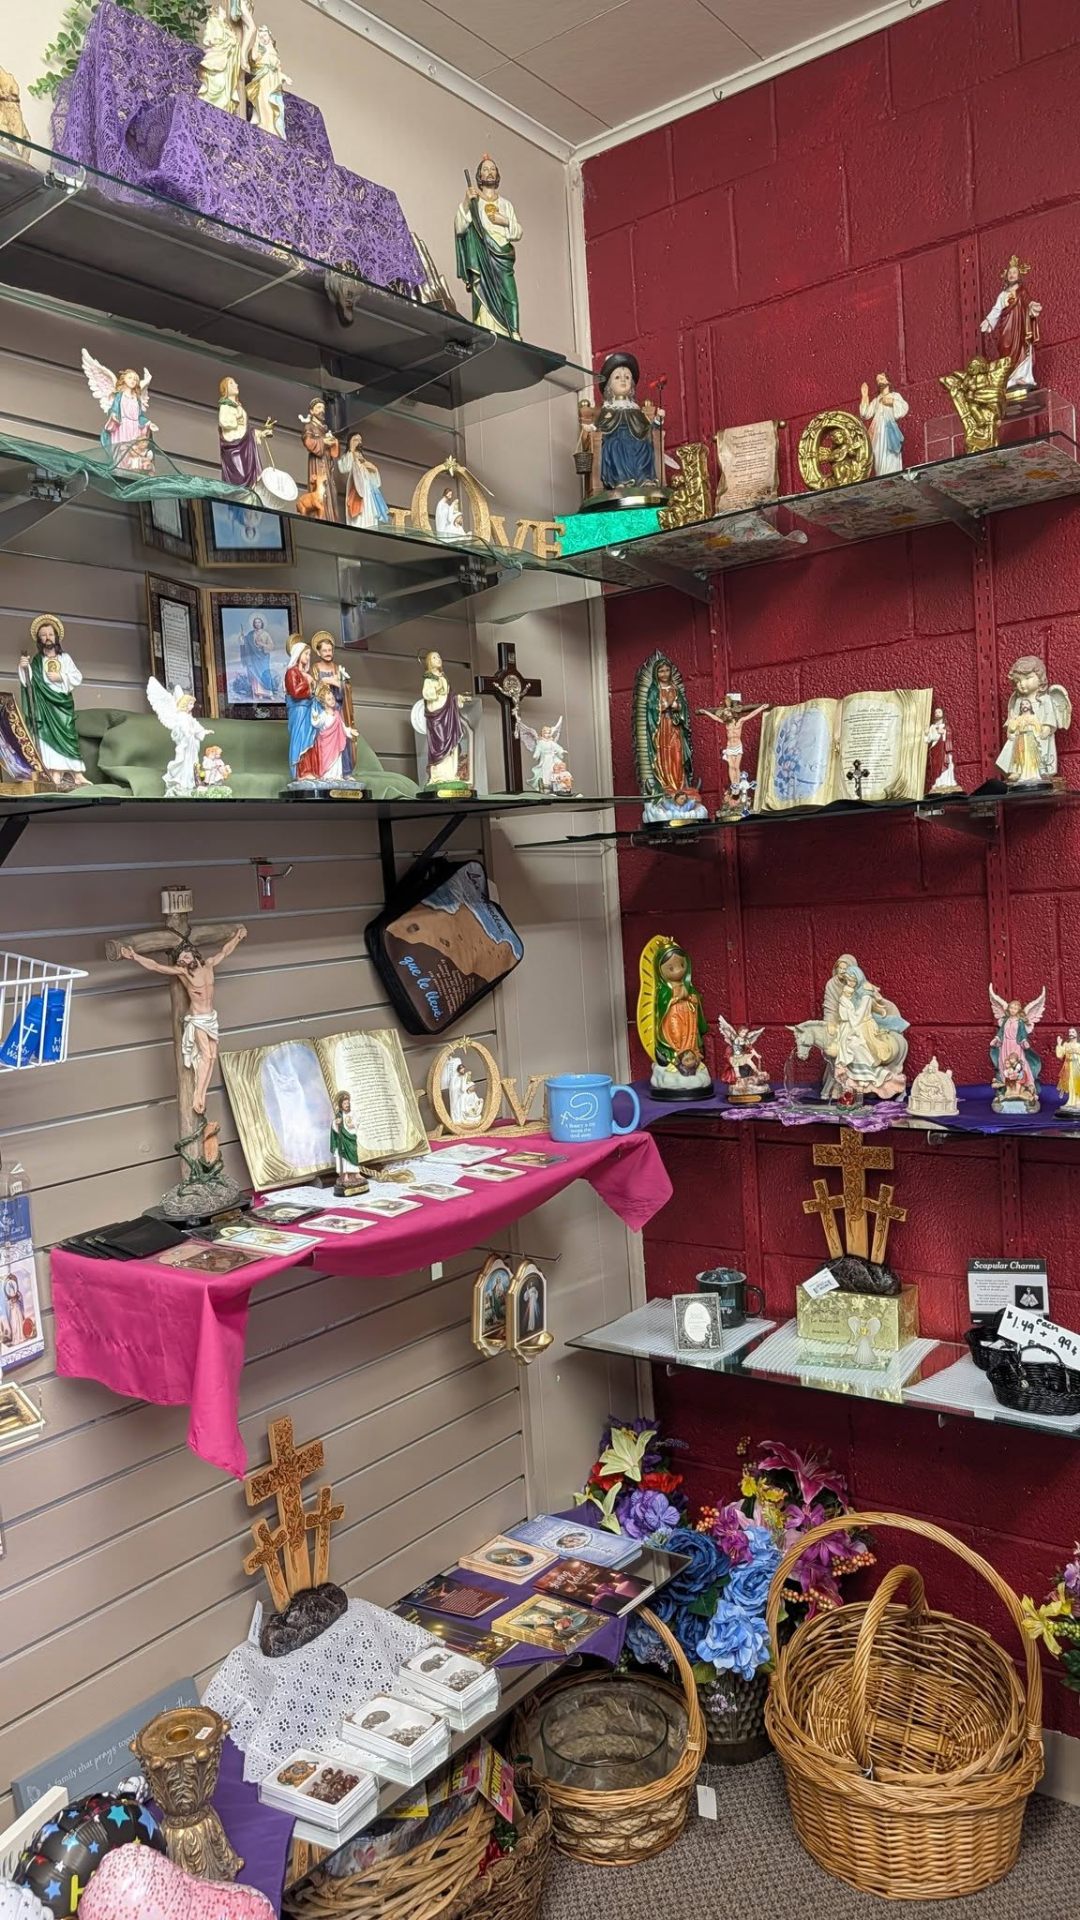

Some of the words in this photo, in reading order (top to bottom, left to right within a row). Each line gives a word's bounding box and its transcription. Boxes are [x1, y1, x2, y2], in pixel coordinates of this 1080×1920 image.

[399, 955, 422, 977] que
[417, 977, 430, 990] le
[11, 1041, 30, 1055] Hly
[973, 1260, 1008, 1270] Scapular
[1009, 1261, 1040, 1270] Charms
[1036, 1318, 1059, 1332] each
[55, 1768, 77, 1786] family
[78, 1760, 94, 1774] that
[94, 1745, 116, 1770] prays
